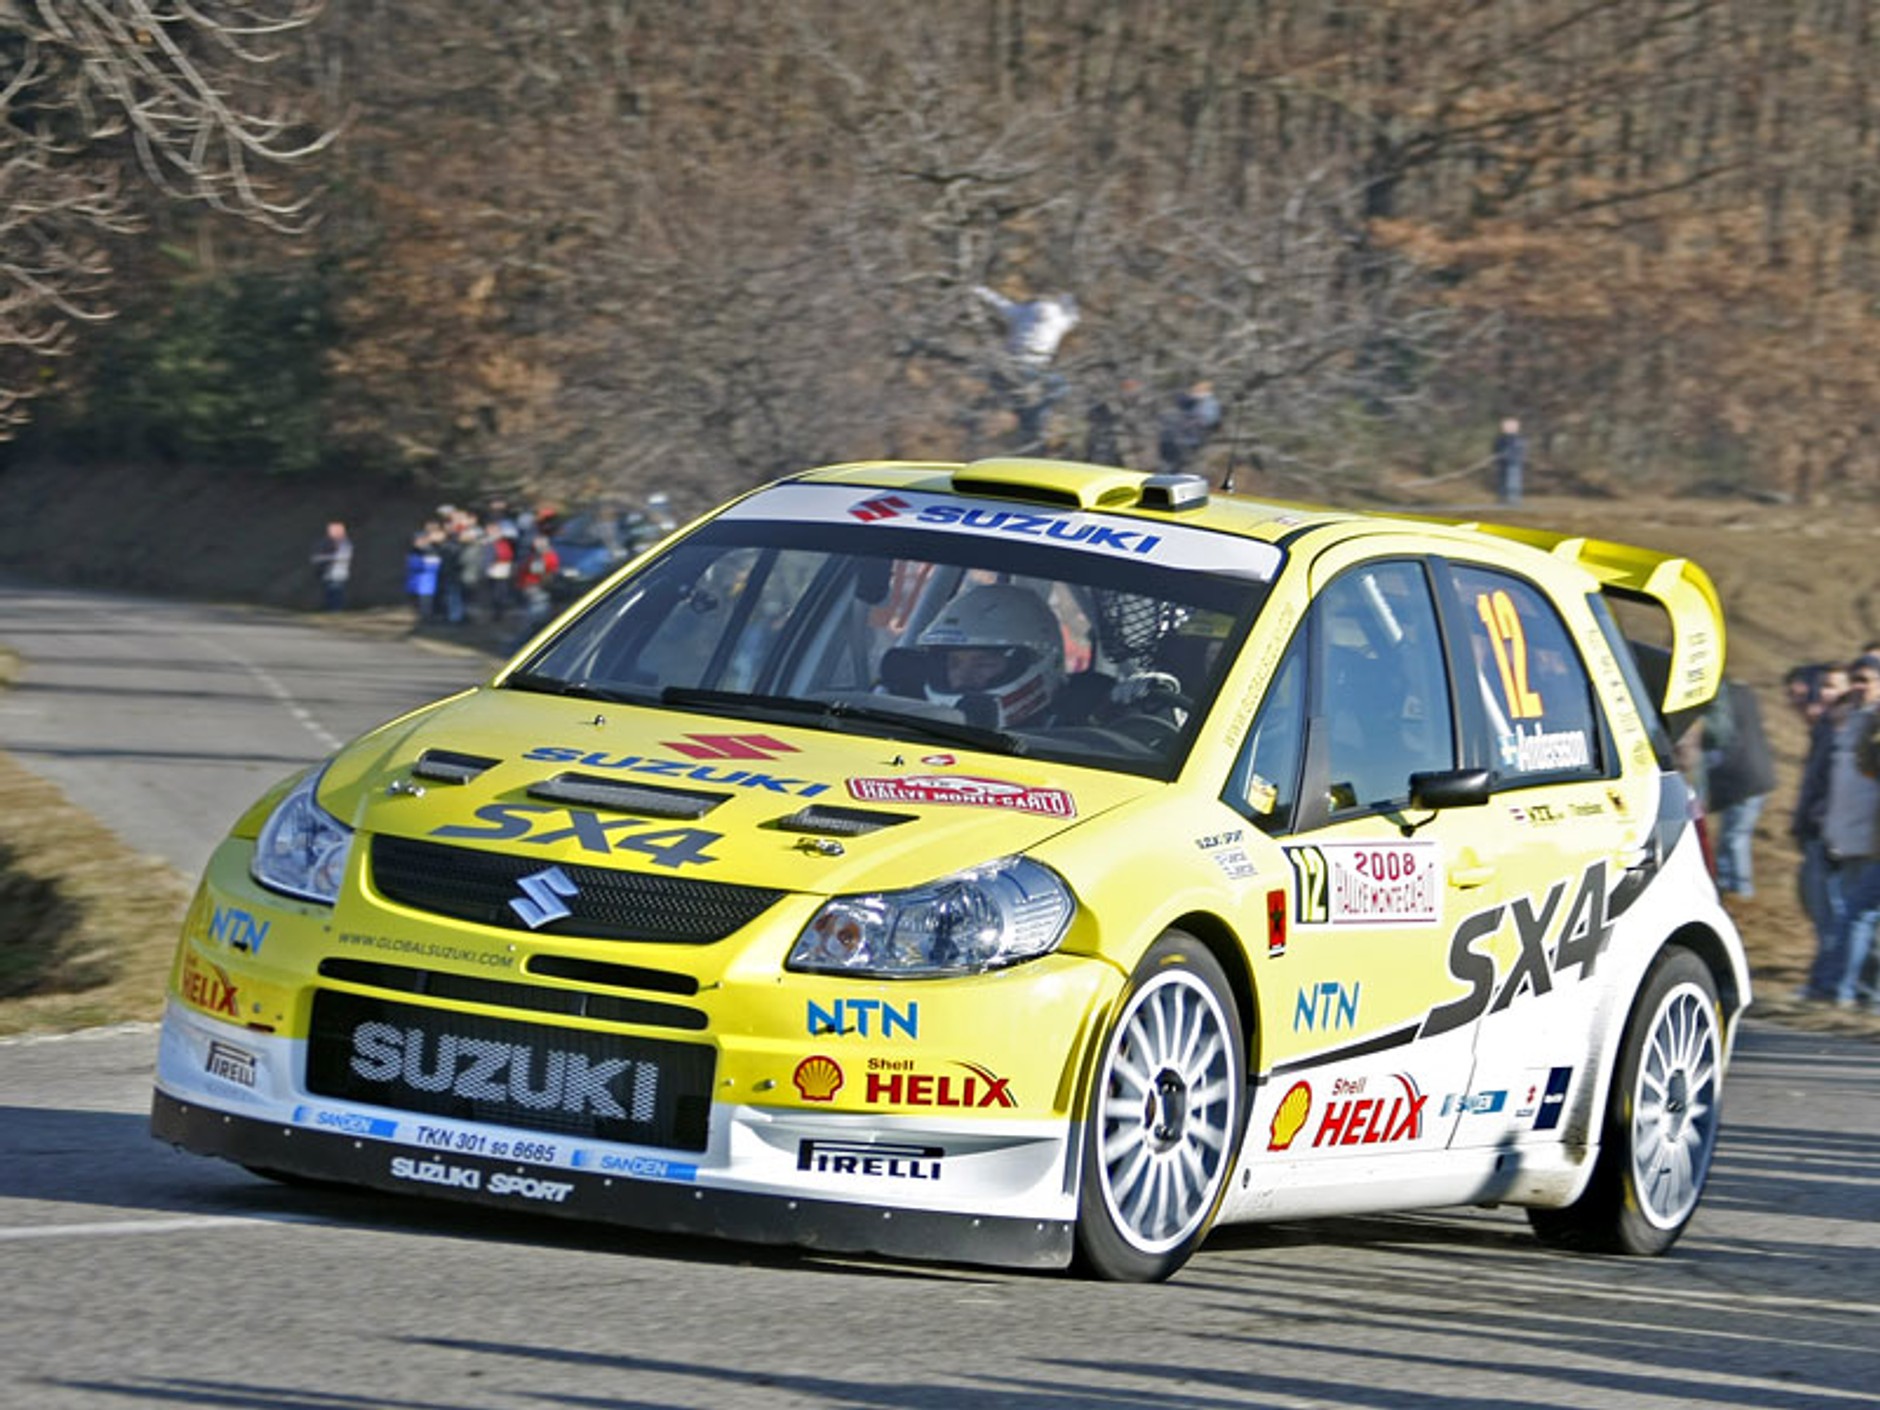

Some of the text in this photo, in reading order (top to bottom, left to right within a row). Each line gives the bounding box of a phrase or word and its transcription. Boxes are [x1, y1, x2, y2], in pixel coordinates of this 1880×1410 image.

[918, 505, 1161, 553] SUZUKI
[1477, 590, 1543, 719] 12
[522, 746, 831, 799] SUZUKI
[427, 803, 724, 869] SX4
[1288, 847, 1327, 922] 12
[1353, 851, 1416, 881] 2008
[208, 907, 272, 956] NTN
[337, 933, 515, 969] WWW.GLOBALSUZUKI.COM
[1418, 861, 1608, 1040] SX4
[807, 999, 918, 1038] NTN
[1293, 982, 1360, 1033] NTN
[205, 1041, 256, 1088] PIRELLI
[350, 1020, 659, 1122] SUZUKI
[866, 1066, 1012, 1108] HELIX
[868, 1058, 915, 1072] Shell
[1332, 1079, 1367, 1097] Shell
[418, 1126, 453, 1147] TKN
[455, 1133, 487, 1153] 301
[1312, 1085, 1428, 1147] HELIX
[390, 1157, 575, 1202] SUZUKI SPORT
[798, 1139, 945, 1180] PIRELLI
